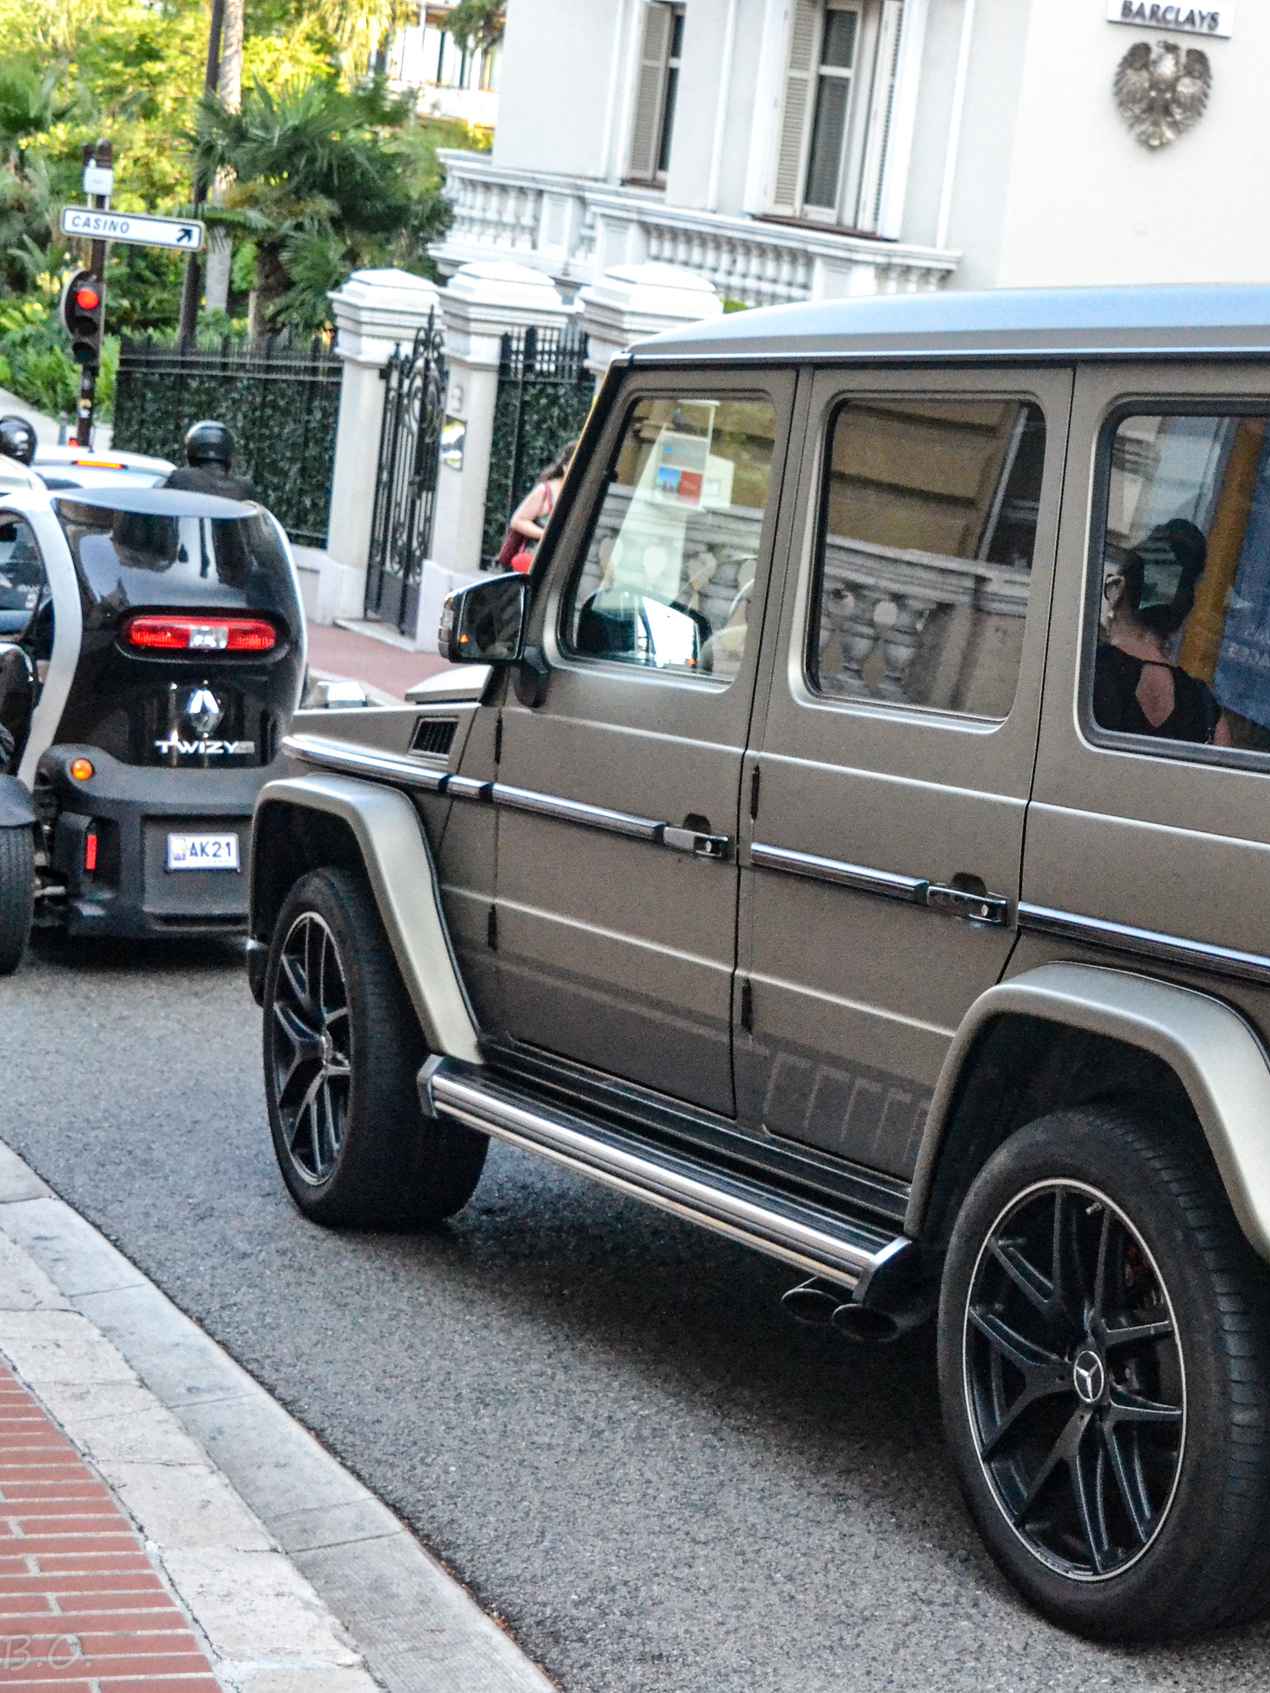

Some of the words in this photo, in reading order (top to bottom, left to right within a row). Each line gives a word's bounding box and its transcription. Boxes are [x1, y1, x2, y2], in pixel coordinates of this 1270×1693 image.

[1121, 0, 1220, 31] BARCLAYS
[71, 215, 131, 234] CASINO
[155, 740, 239, 754] TWIZY
[189, 841, 232, 858] AK21
